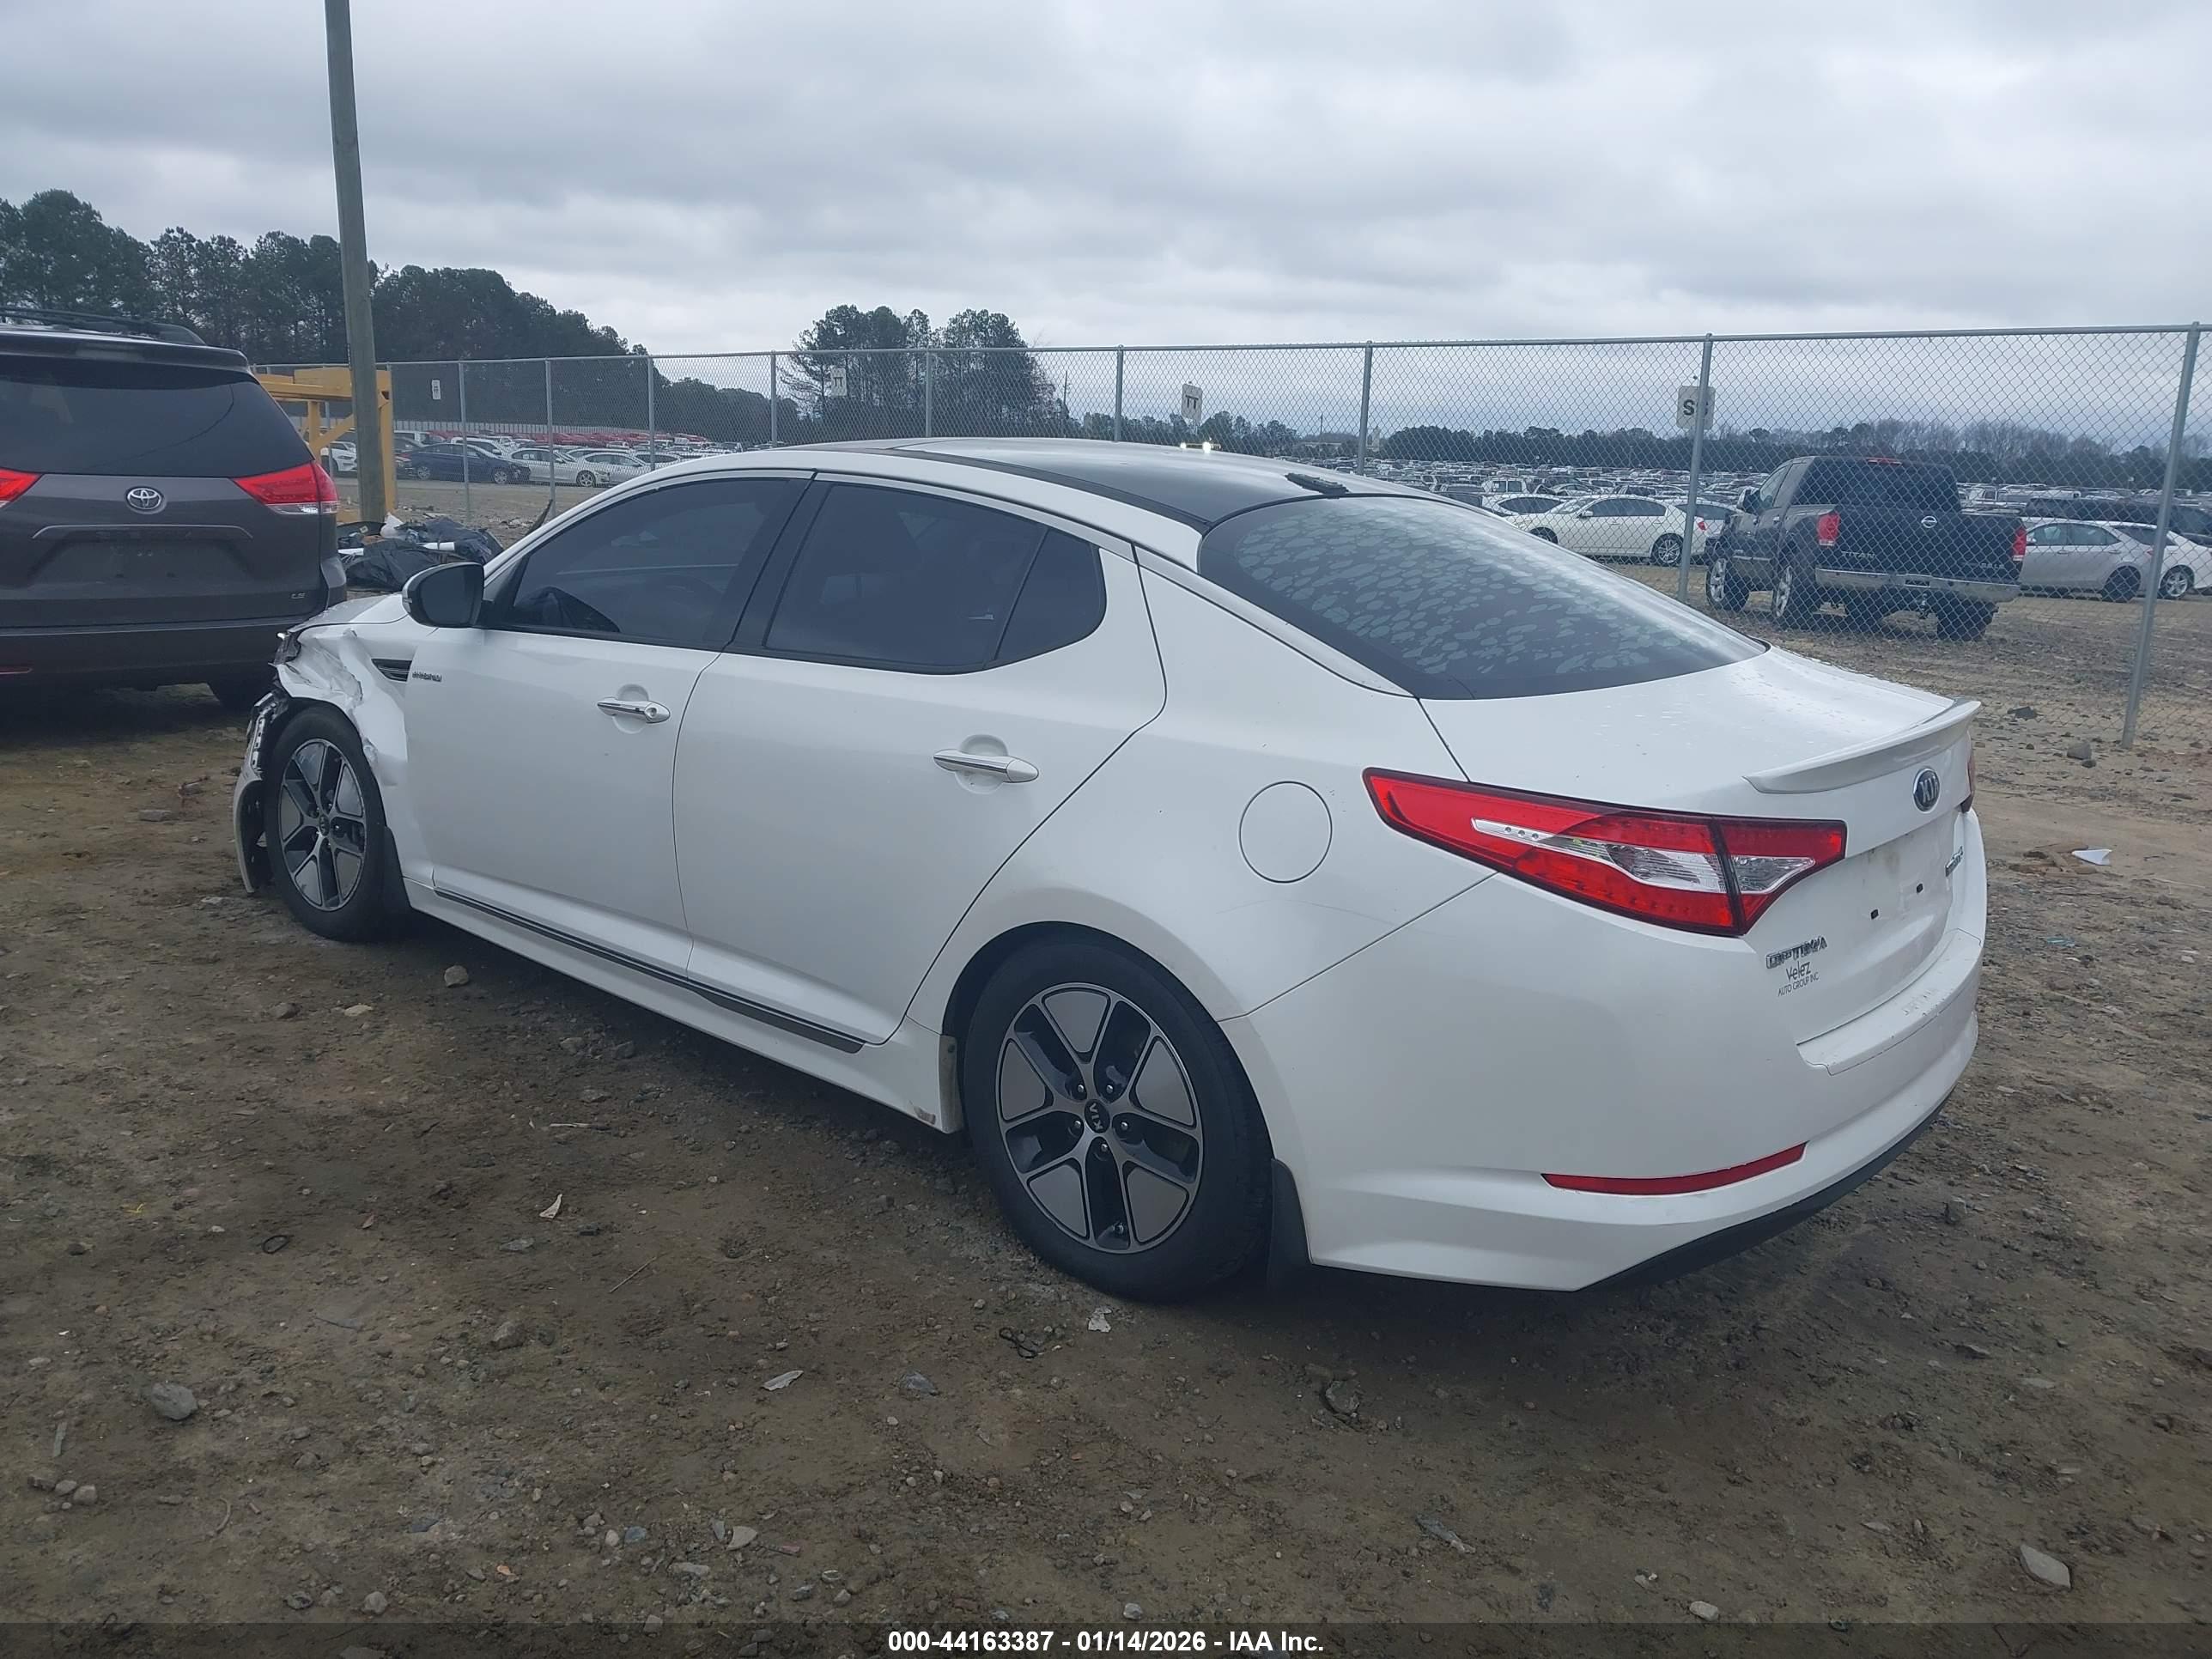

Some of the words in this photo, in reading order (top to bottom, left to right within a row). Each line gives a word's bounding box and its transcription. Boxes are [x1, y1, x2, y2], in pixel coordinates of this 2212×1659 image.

[1765, 936, 1828, 969] OPTIMA
[1785, 960, 1812, 982] Velez
[1778, 983, 1793, 997] AUTO
[1792, 975, 1810, 990] GROUP
[1089, 1102, 1104, 1131] KIA
